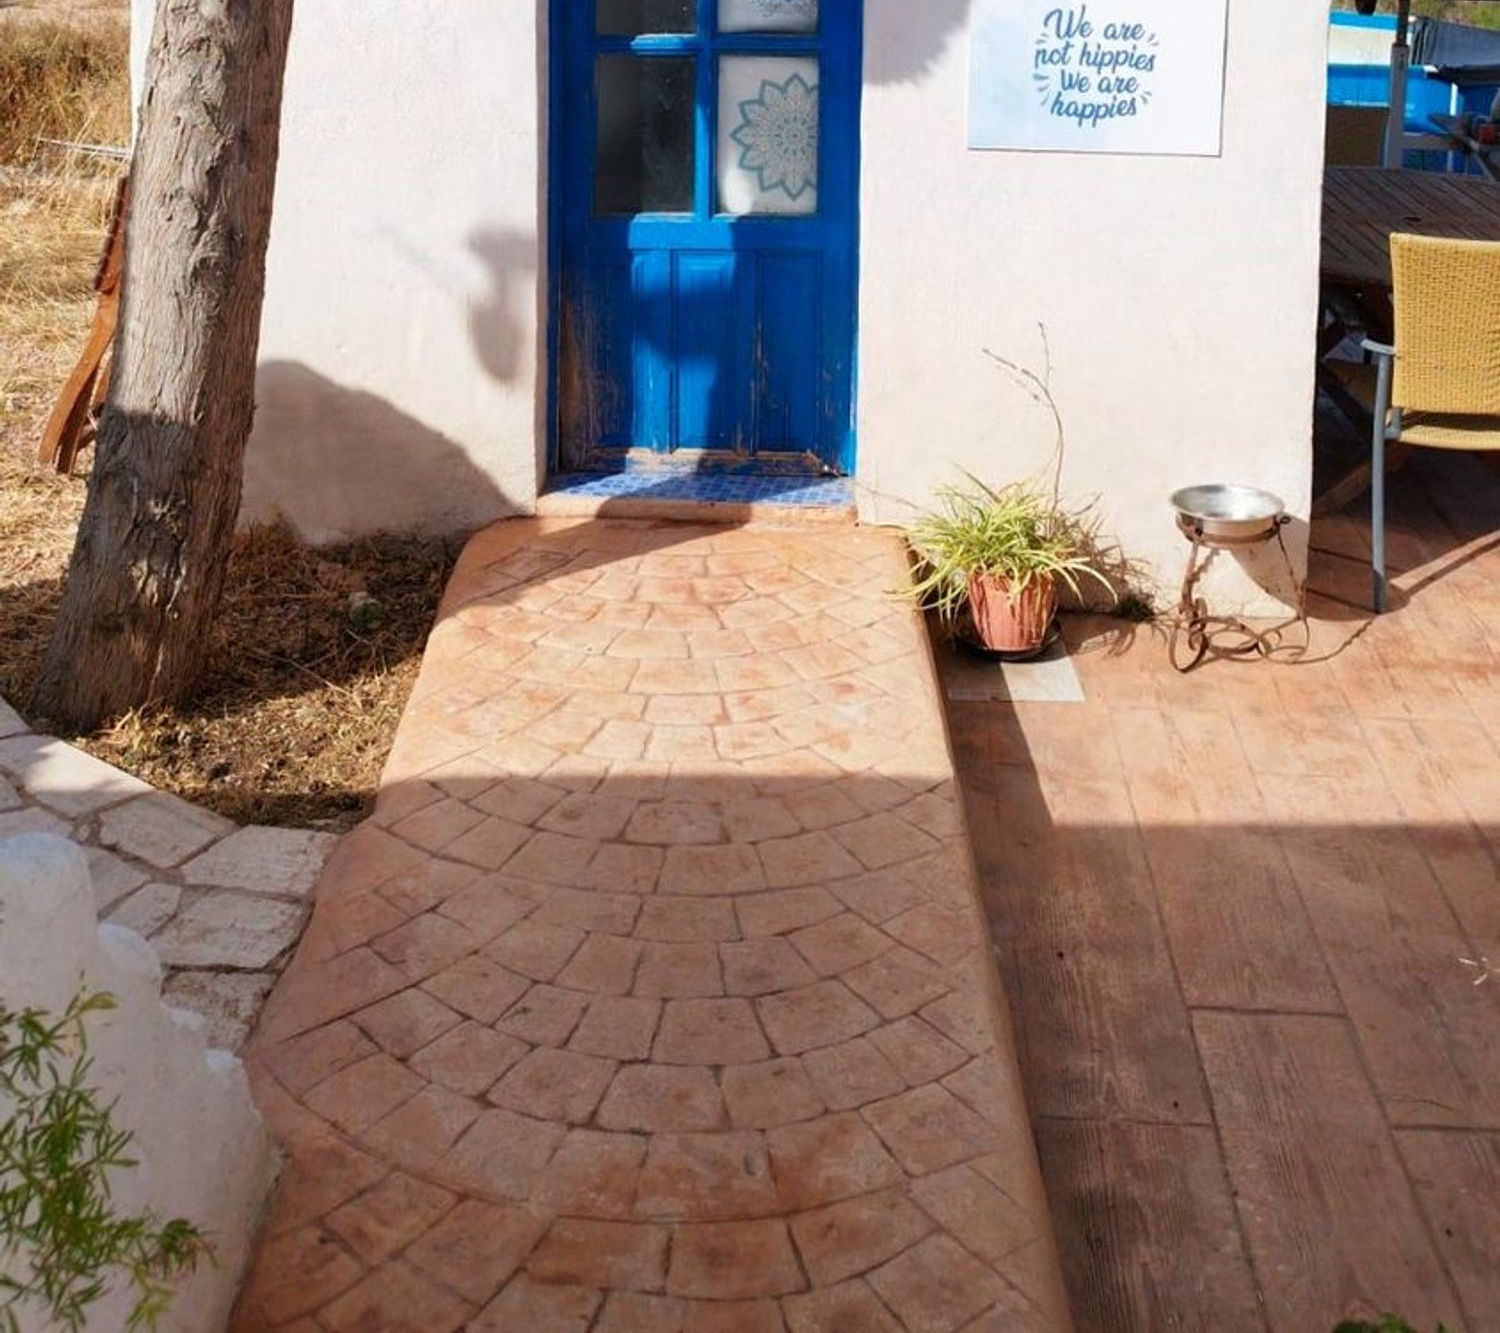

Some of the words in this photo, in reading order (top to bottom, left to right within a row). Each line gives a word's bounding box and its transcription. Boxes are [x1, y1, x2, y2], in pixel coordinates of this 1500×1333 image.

[1043, 3, 1094, 40] We
[1103, 22, 1146, 41] are
[1034, 40, 1075, 69] not
[1079, 41, 1157, 74] hippies
[1060, 68, 1092, 93] We
[1097, 75, 1139, 93] are
[1050, 90, 1137, 128] happies
